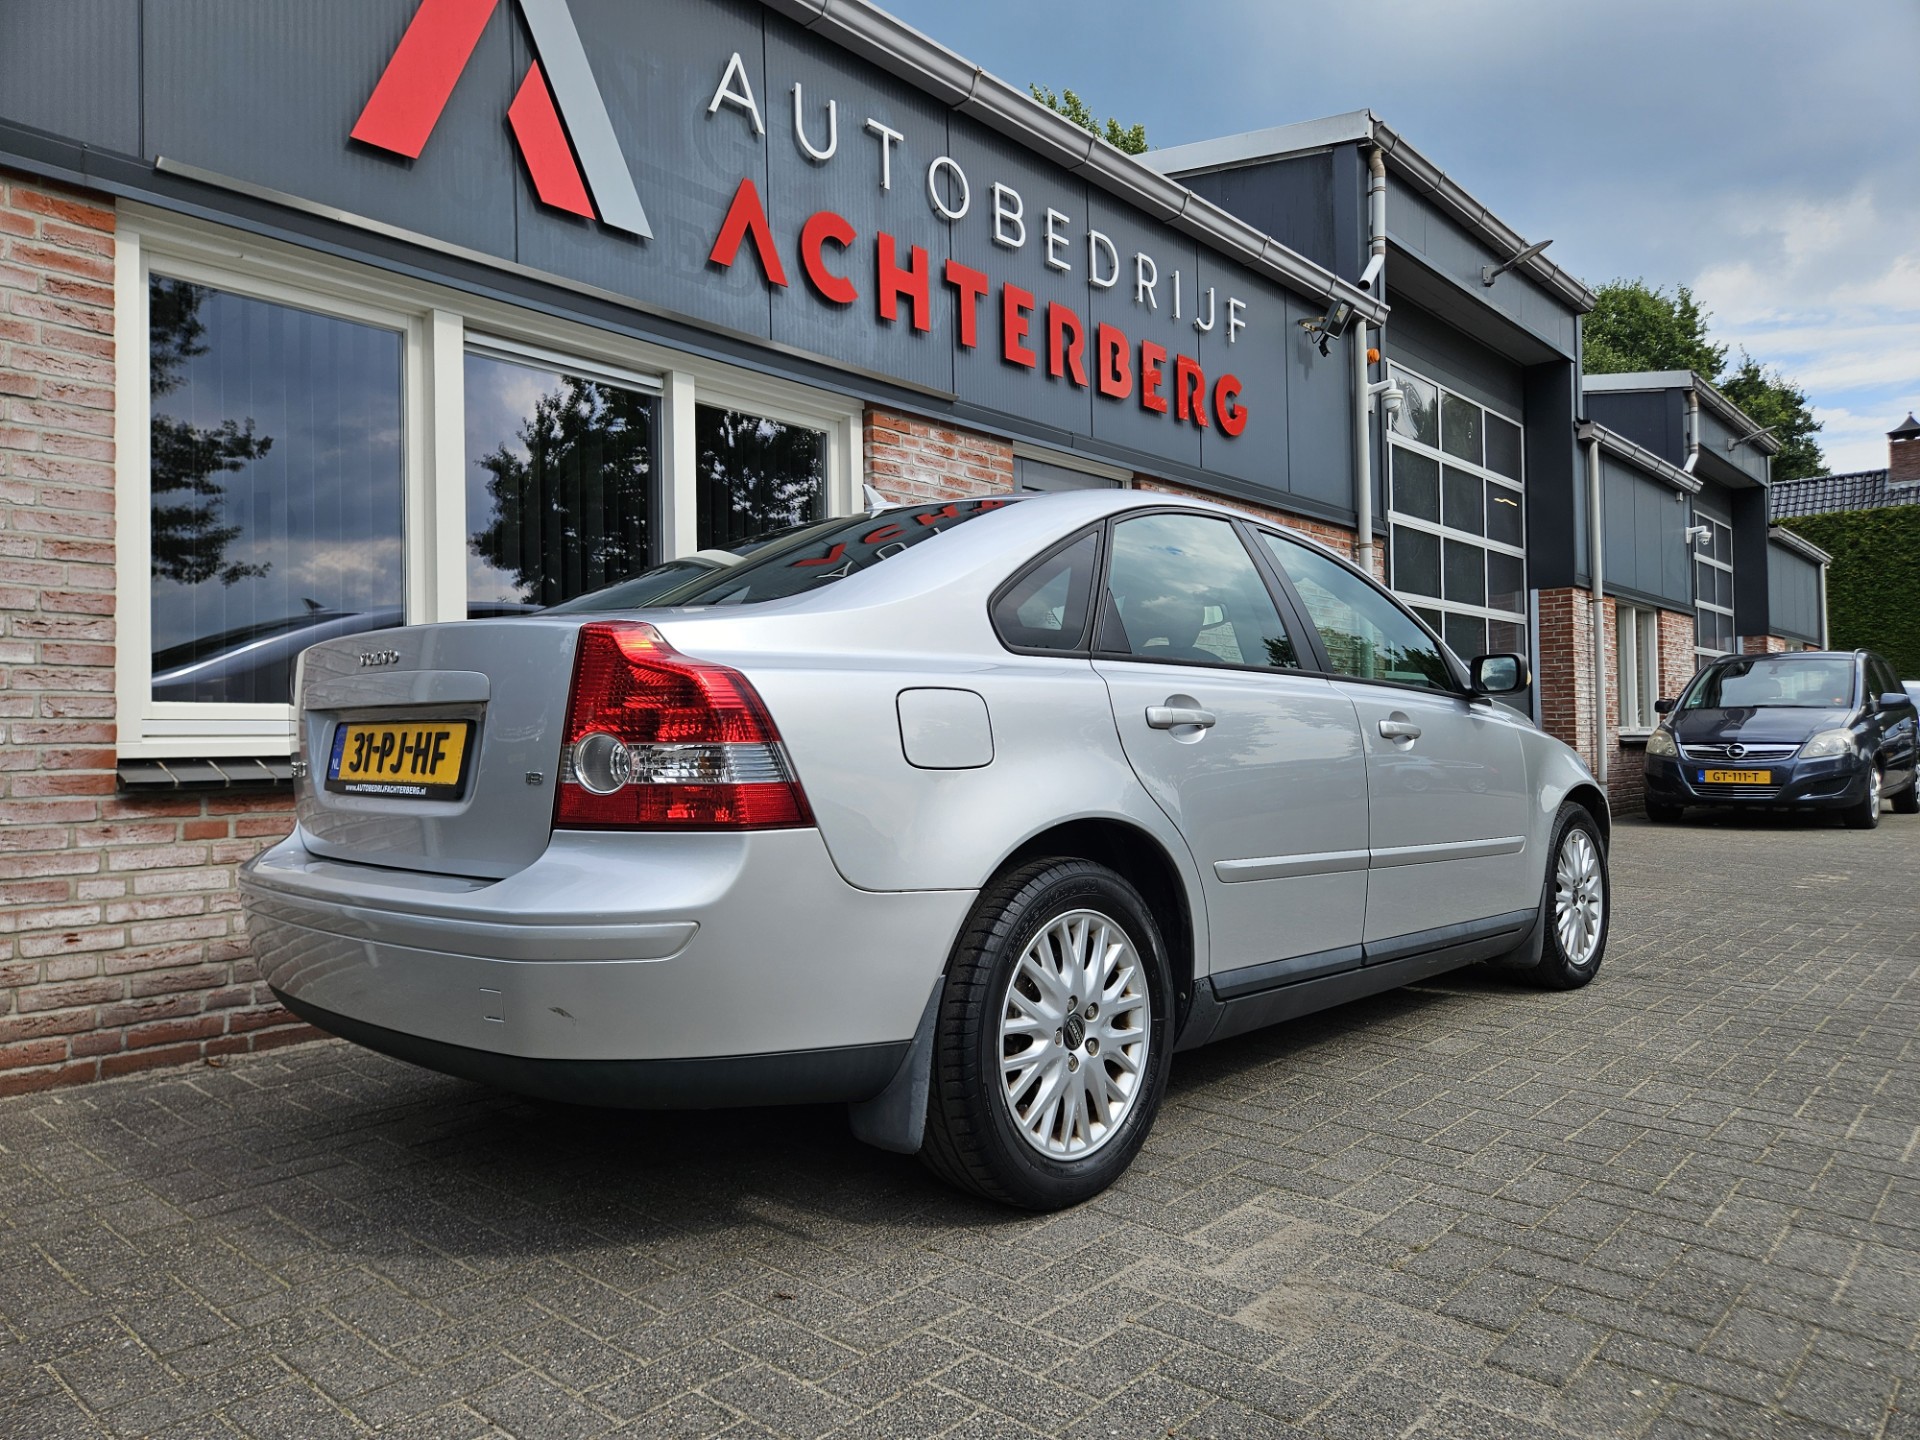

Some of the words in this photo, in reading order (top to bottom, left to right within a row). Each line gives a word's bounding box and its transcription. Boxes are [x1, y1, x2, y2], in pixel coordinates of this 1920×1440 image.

[708, 51, 1247, 343] AUTOBEDRIJF
[709, 177, 1248, 437] ACHTERBERG
[359, 650, 400, 667] VOLVO
[331, 758, 340, 770] NL
[348, 731, 451, 776] 31-PJ-HF
[1713, 771, 1759, 782] GT-111-T
